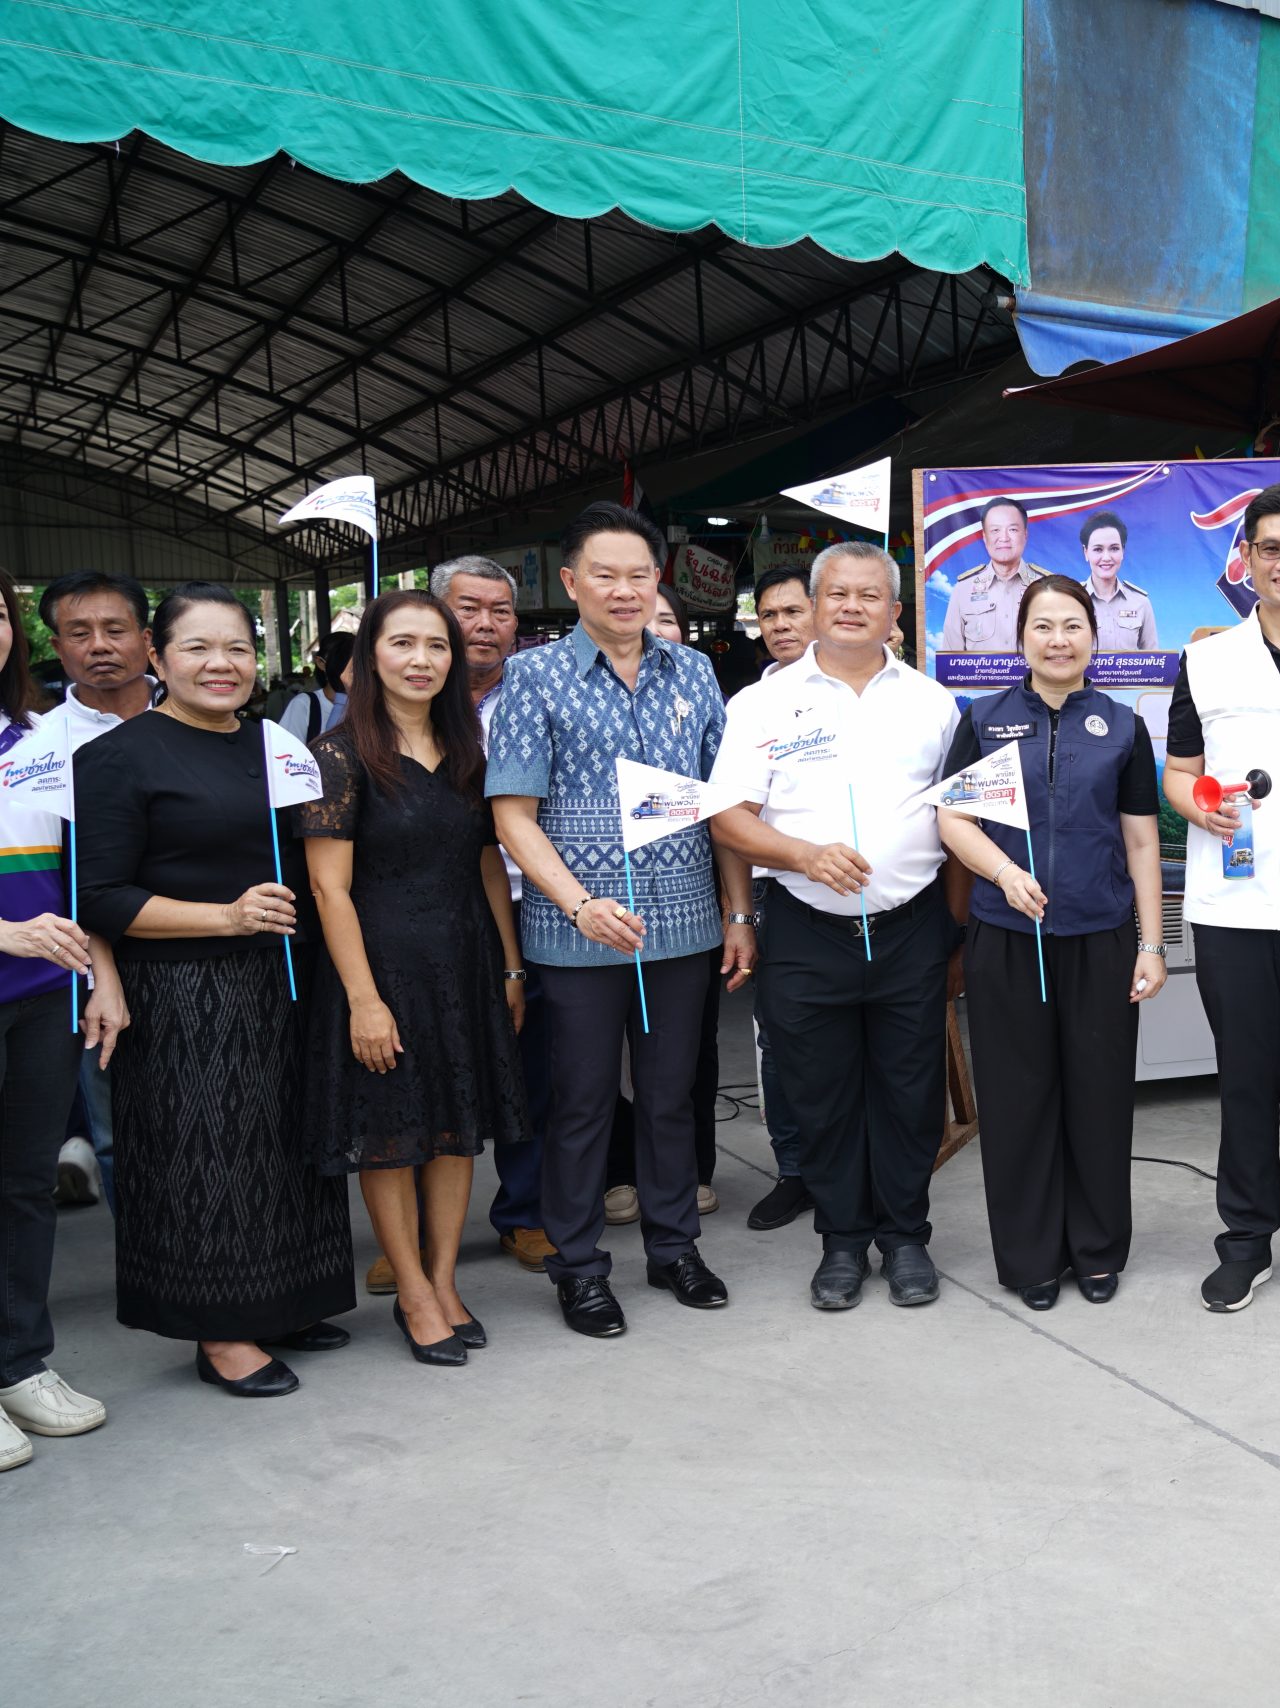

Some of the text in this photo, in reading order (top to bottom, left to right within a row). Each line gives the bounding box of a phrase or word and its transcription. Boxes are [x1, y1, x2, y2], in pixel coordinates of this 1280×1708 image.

[949, 657, 991, 669] นายอนุทิน
[975, 667, 1011, 675] นายกรัฐมนตรี
[1097, 669, 1143, 677] รองนายกรัฐมนตรี
[756, 728, 837, 760] ไทยช่วยไทย
